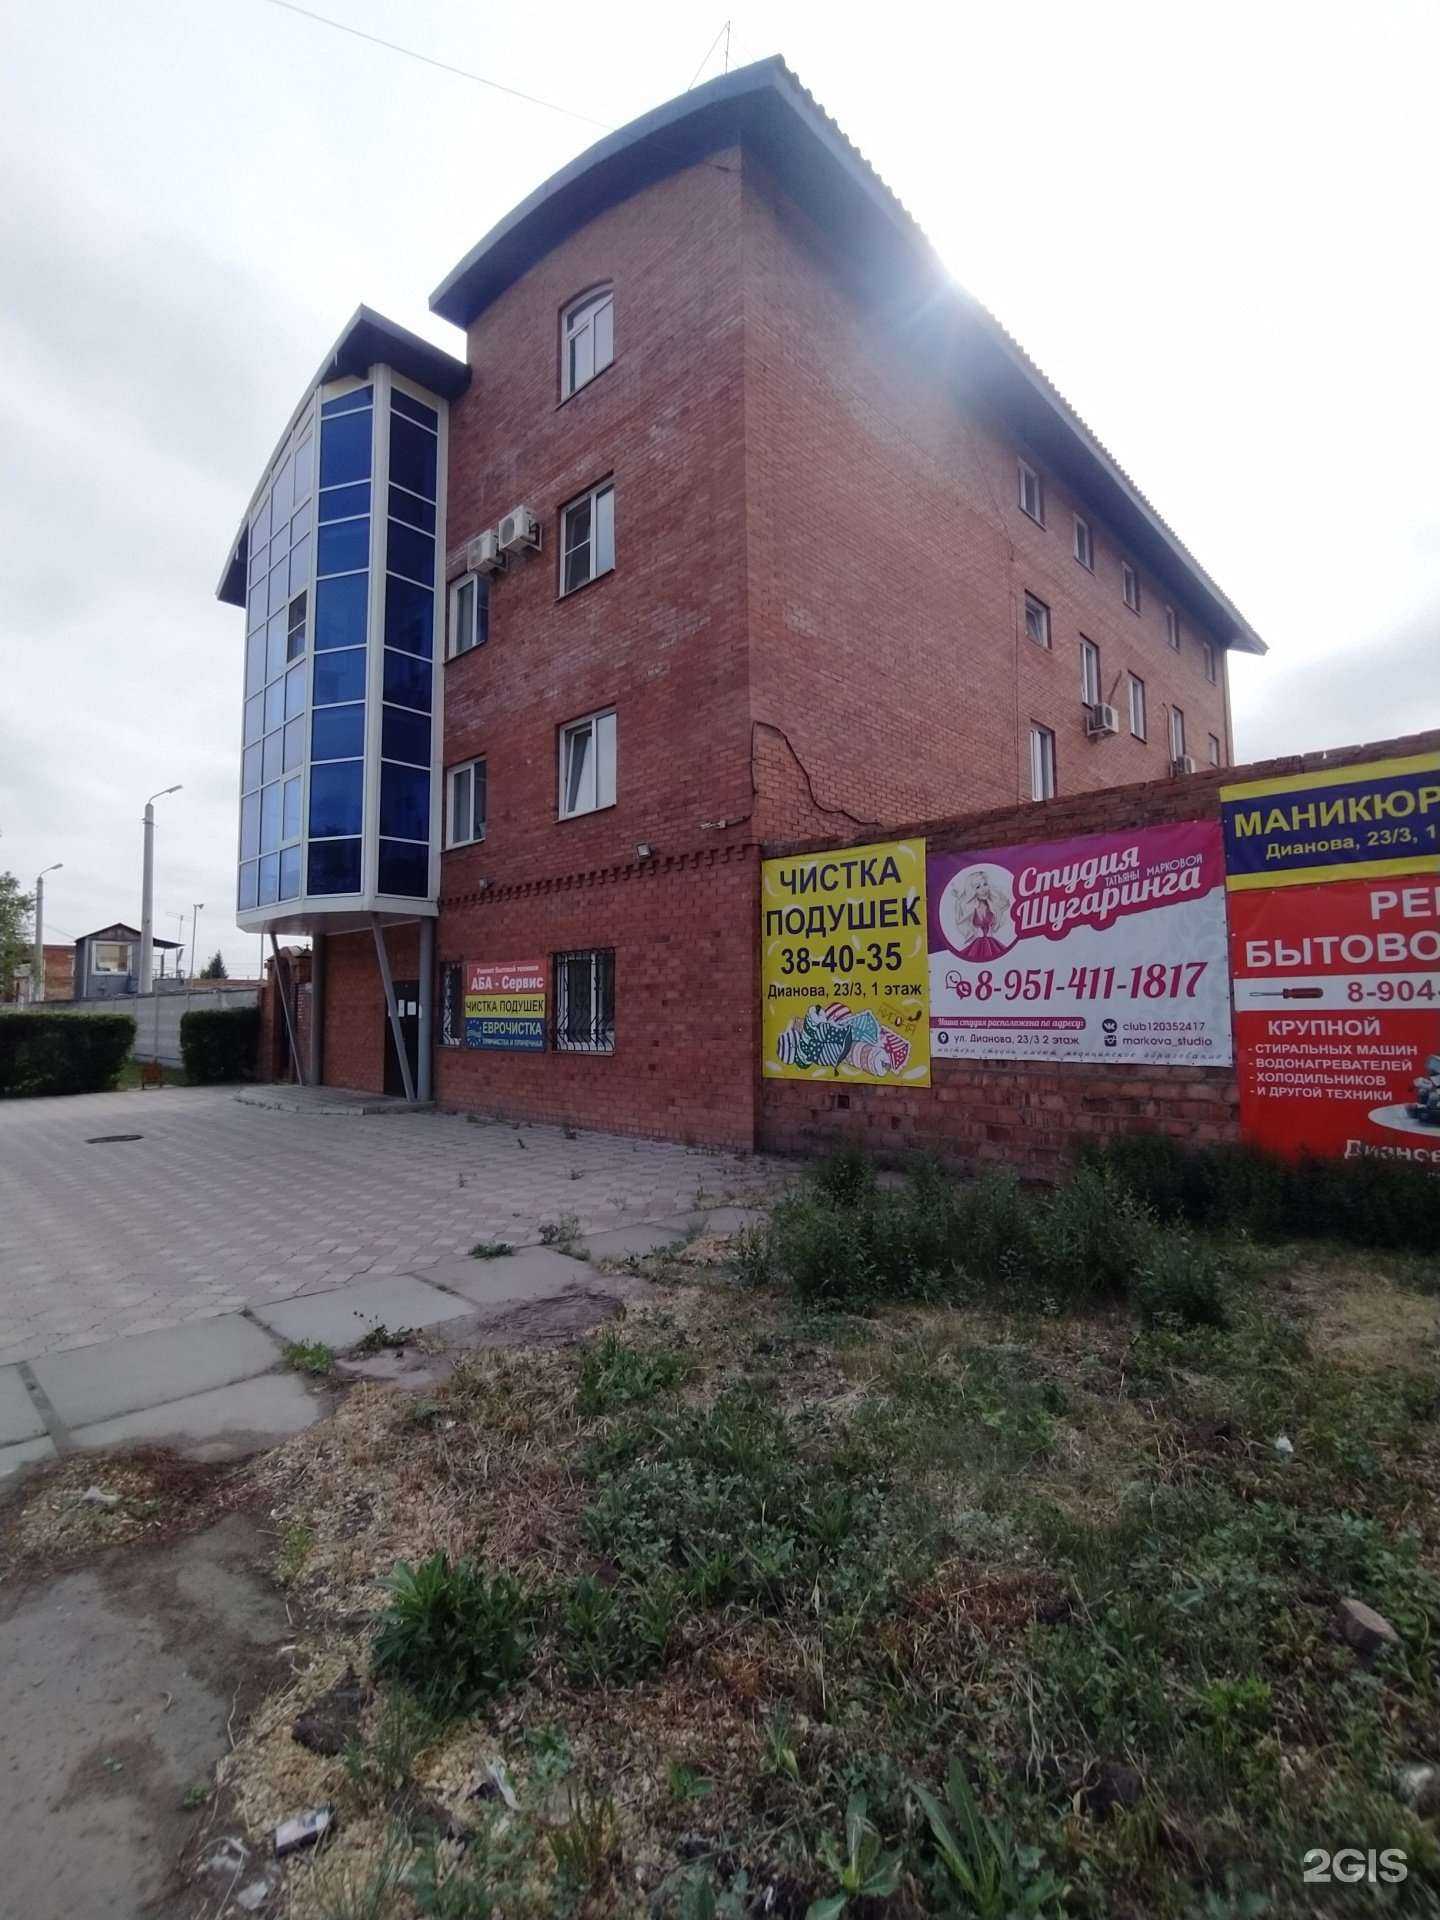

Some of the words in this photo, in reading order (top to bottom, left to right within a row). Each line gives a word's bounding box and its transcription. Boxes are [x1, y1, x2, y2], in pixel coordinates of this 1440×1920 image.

[1234, 786, 1440, 838] МАНИКЮР
[1265, 836, 1360, 860] Дианова,
[1367, 827, 1418, 847] 23/3,
[1426, 824, 1436, 839] 1
[780, 856, 901, 895] ЧИСТКА
[1018, 846, 1140, 897] Студия
[1104, 869, 1140, 888] ТАТЬЯНЫ
[1146, 853, 1203, 877] МАРКОВОЙ
[1016, 866, 1202, 932] Шугаринга
[1370, 886, 1440, 920] РЕ
[766, 896, 921, 939] ПОДУШЕК
[780, 942, 903, 975] 38-40-35
[1246, 930, 1440, 968] БЫТОВО
[471, 976, 493, 991] АБА
[502, 975, 545, 992] Сервис
[768, 984, 829, 999] Дианова,
[833, 982, 866, 998] 23/3,
[872, 982, 878, 996] 1
[884, 983, 922, 996] этаж
[974, 961, 1208, 1001] 8-951-411-1817
[1347, 979, 1440, 1003] 8-904
[466, 1001, 496, 1013] ЧИСТКА
[500, 999, 544, 1013] ПОДУШЕК
[482, 1021, 542, 1035] ЕВРОЧИСТКА
[1122, 1021, 1206, 1032] club120352417
[1268, 1016, 1381, 1037] КРУПНОЙ
[970, 1033, 1015, 1045] Дианова,
[1017, 1034, 1040, 1045] 23/3
[1042, 1034, 1049, 1045] 2
[1052, 1035, 1079, 1045] этаж
[1122, 1036, 1213, 1047] markova_studio
[1255, 1043, 1353, 1055] СТИРАЛЬНЫХ
[1356, 1045, 1418, 1056] МАШИН
[1255, 1058, 1413, 1072] ВОДОНАГРЕВАТЕЛЕЙ
[1256, 1072, 1387, 1086] ХОЛОДИЛЬНИКОВ
[1257, 1087, 1266, 1096] И
[1269, 1087, 1322, 1098] ДРУГОЙ
[1326, 1088, 1393, 1101] ТЕХНИКИ
